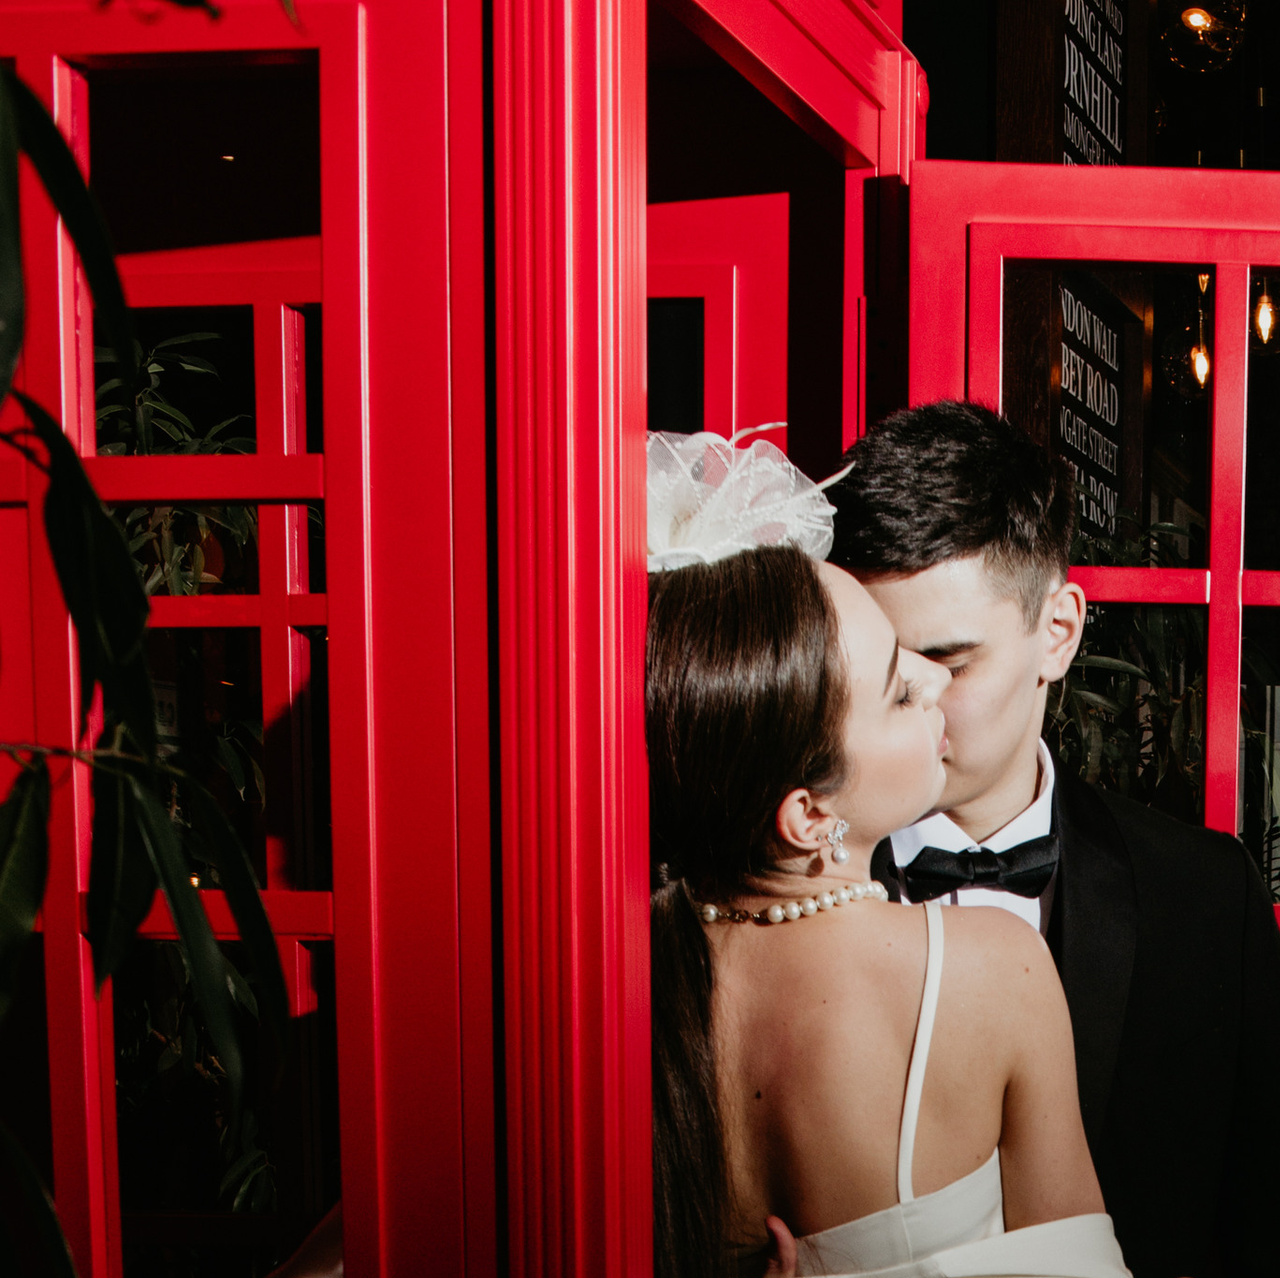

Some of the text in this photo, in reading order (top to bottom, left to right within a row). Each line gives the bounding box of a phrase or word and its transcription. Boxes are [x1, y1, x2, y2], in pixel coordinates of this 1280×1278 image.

[1097, 20, 1123, 86] LANE
[1092, 313, 1119, 372] WALL
[1061, 341, 1119, 426] BEY ROAD
[1089, 426, 1118, 476] STREET
